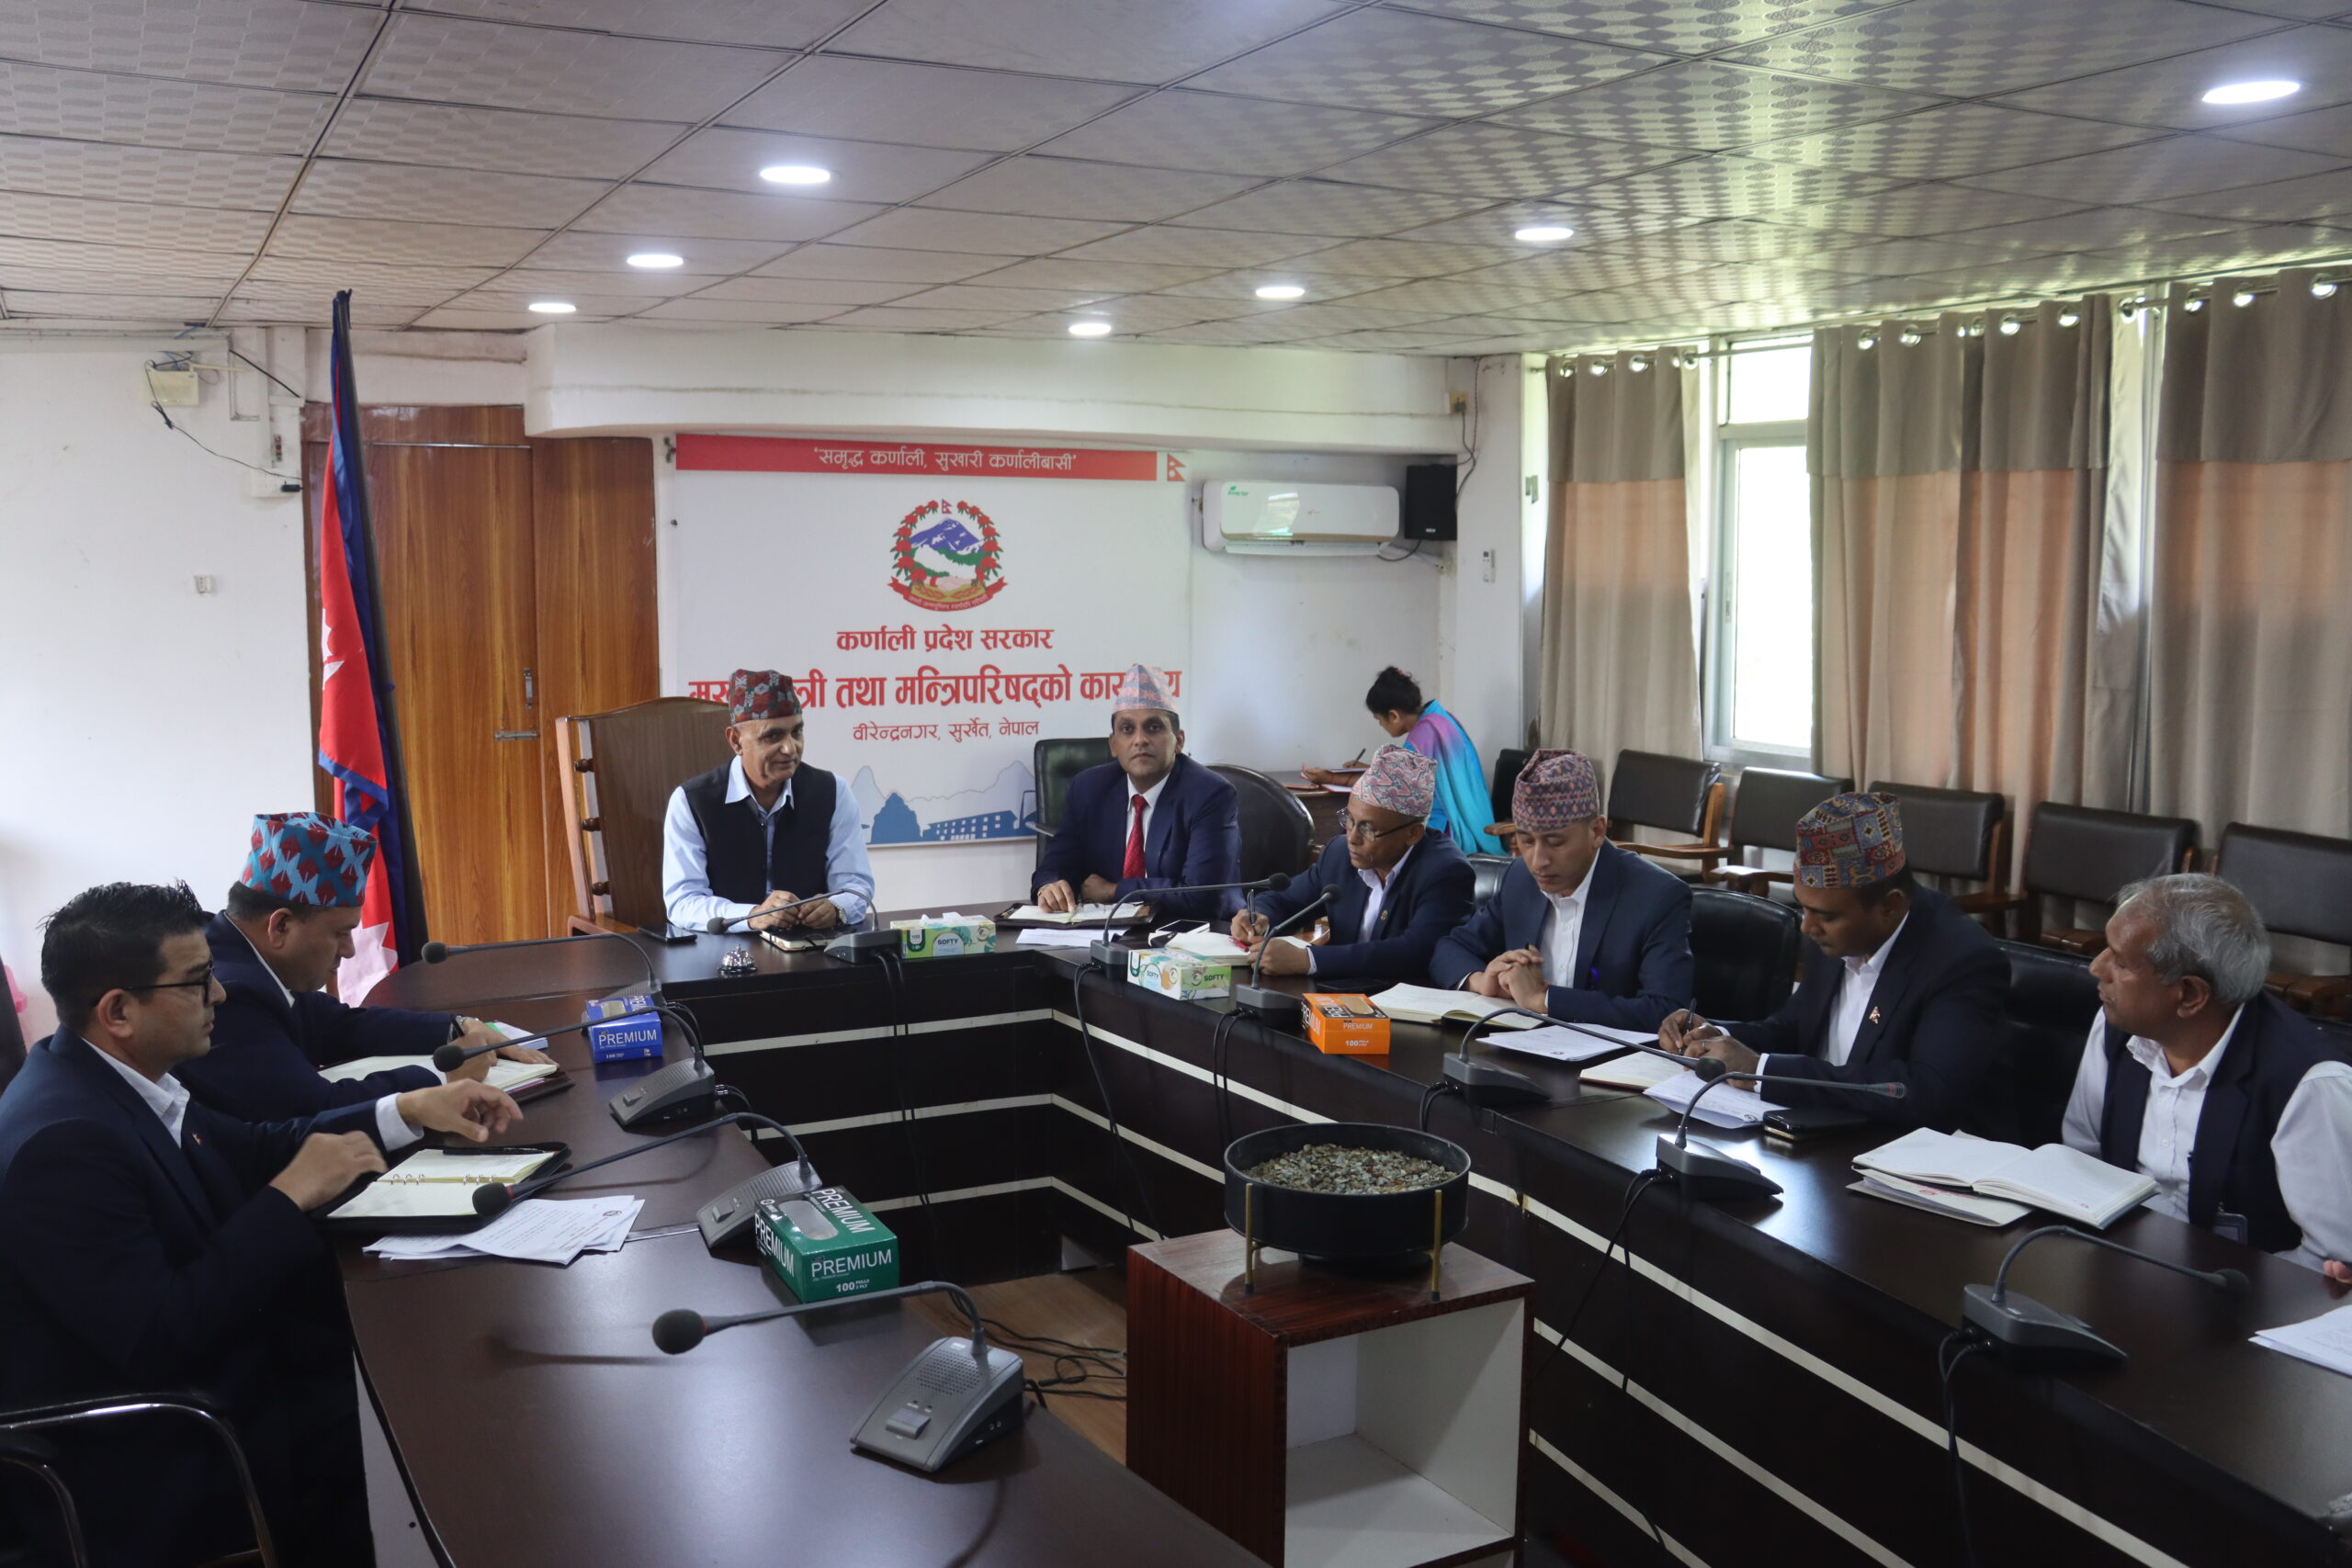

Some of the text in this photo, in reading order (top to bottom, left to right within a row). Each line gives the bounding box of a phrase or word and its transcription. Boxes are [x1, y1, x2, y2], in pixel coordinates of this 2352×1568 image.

[836, 624, 1055, 653] कर्णाली प्रदेश सरकार
[835, 676, 888, 709] तथा
[895, 663, 1074, 708] मन्त्रिपरिषद्को
[853, 720, 941, 742] वीरेन्द्रनगर,
[999, 716, 1040, 736] नेपाल
[1204, 974, 1225, 982] SOFTY
[599, 1029, 657, 1046] PREMIUM
[1345, 1039, 1359, 1047] 100
[810, 1188, 876, 1234] PREMIUM
[754, 1212, 795, 1278] PREMIUM
[811, 1248, 892, 1278] PREMIUM
[836, 1281, 855, 1292] 100
